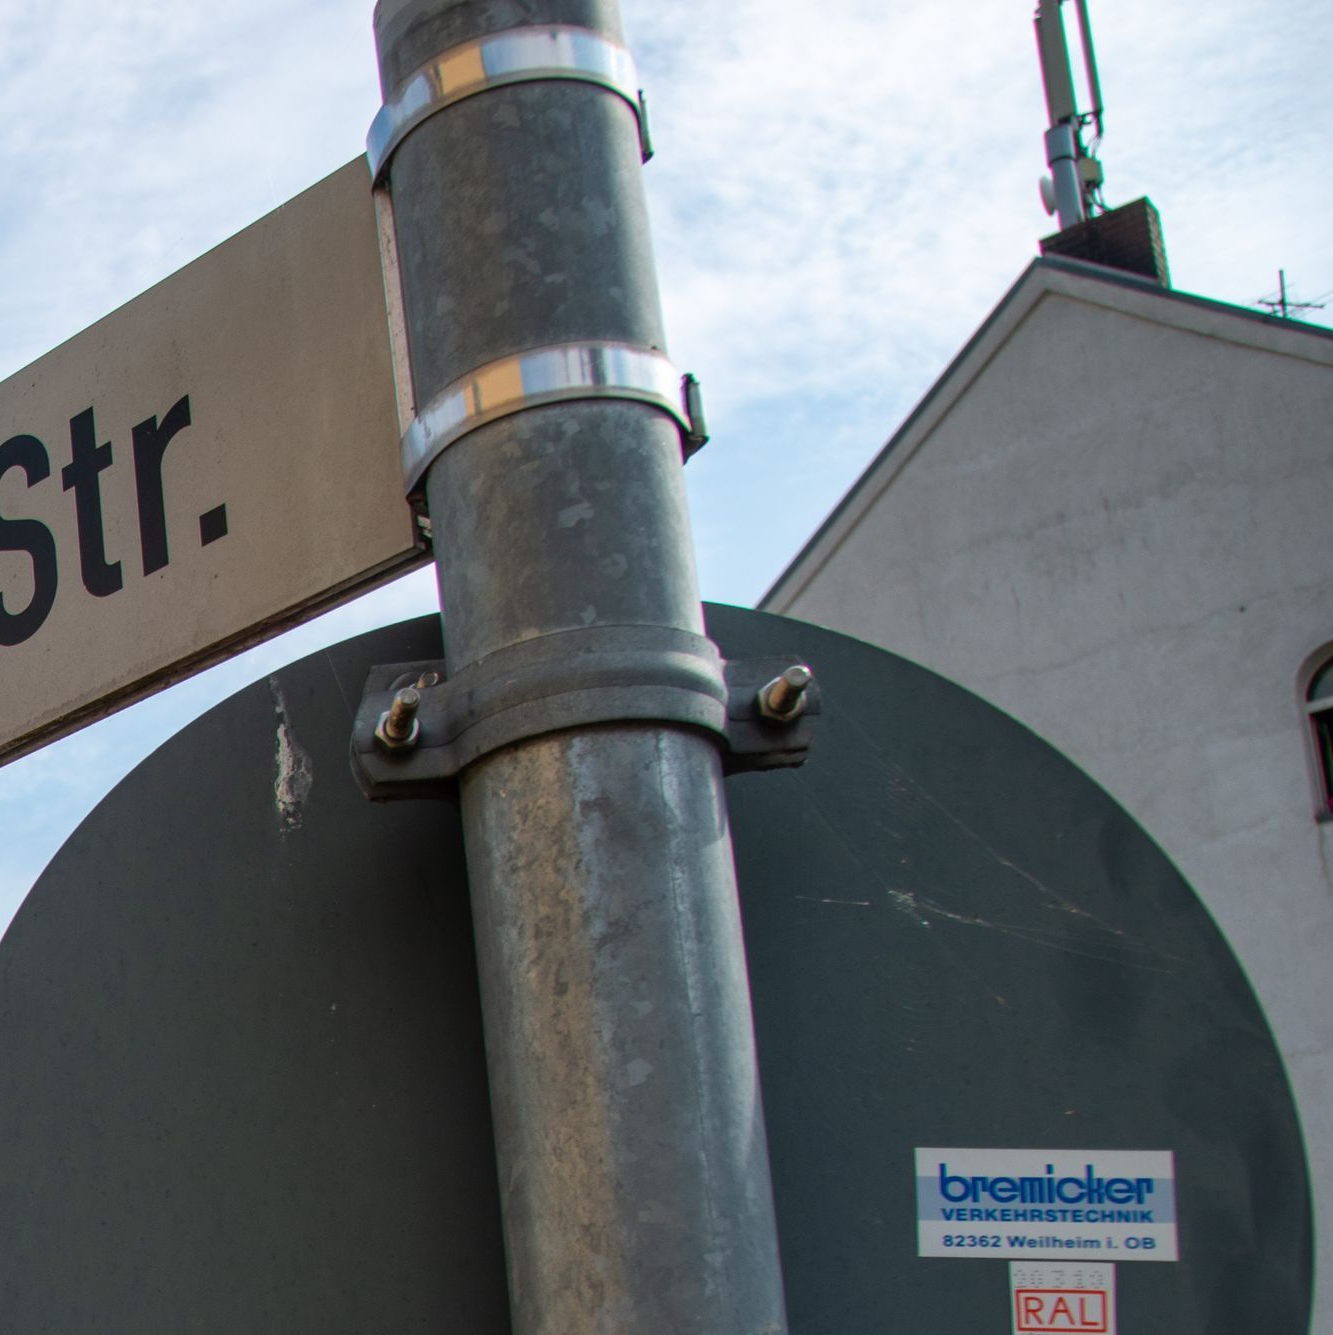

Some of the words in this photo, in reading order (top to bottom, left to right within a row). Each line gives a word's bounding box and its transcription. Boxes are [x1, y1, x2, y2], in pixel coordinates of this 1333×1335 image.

[938, 1162, 1154, 1204] bremicker
[941, 1208, 1154, 1223] VERKEHRSTECHNIK
[942, 1235, 1002, 1248] 82362
[1006, 1235, 1101, 1249] Weilheim
[1106, 1237, 1119, 1249] i.
[1124, 1237, 1157, 1250] OB
[1023, 1296, 1100, 1326] RAL
